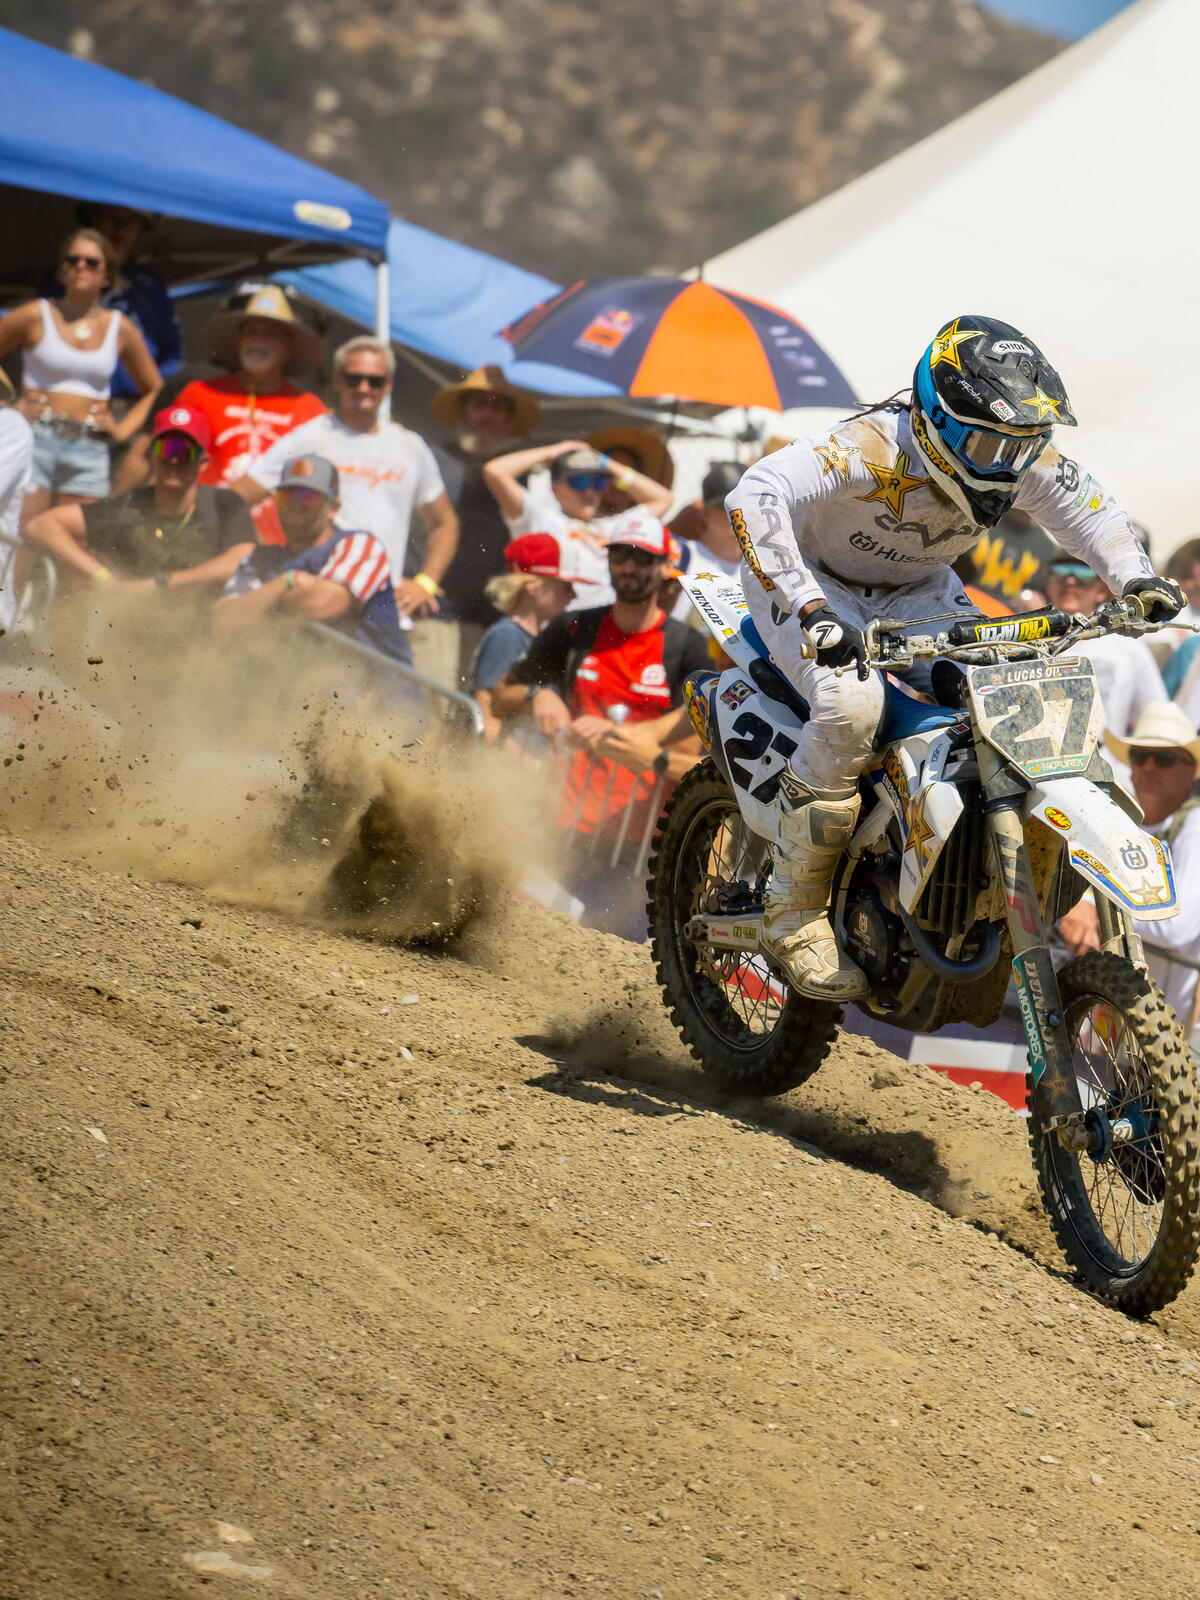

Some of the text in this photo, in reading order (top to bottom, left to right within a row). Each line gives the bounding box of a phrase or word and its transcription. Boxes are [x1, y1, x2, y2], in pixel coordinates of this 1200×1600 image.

[691, 589, 725, 627] DUNLOP
[1008, 667, 1062, 683] LUCAS OIL
[983, 678, 1095, 762] 27
[724, 712, 799, 804] 27
[1042, 758, 1084, 771] MOTOREX
[1075, 848, 1109, 875] ROCKSTAR
[1018, 987, 1044, 1065] MOTOREX
